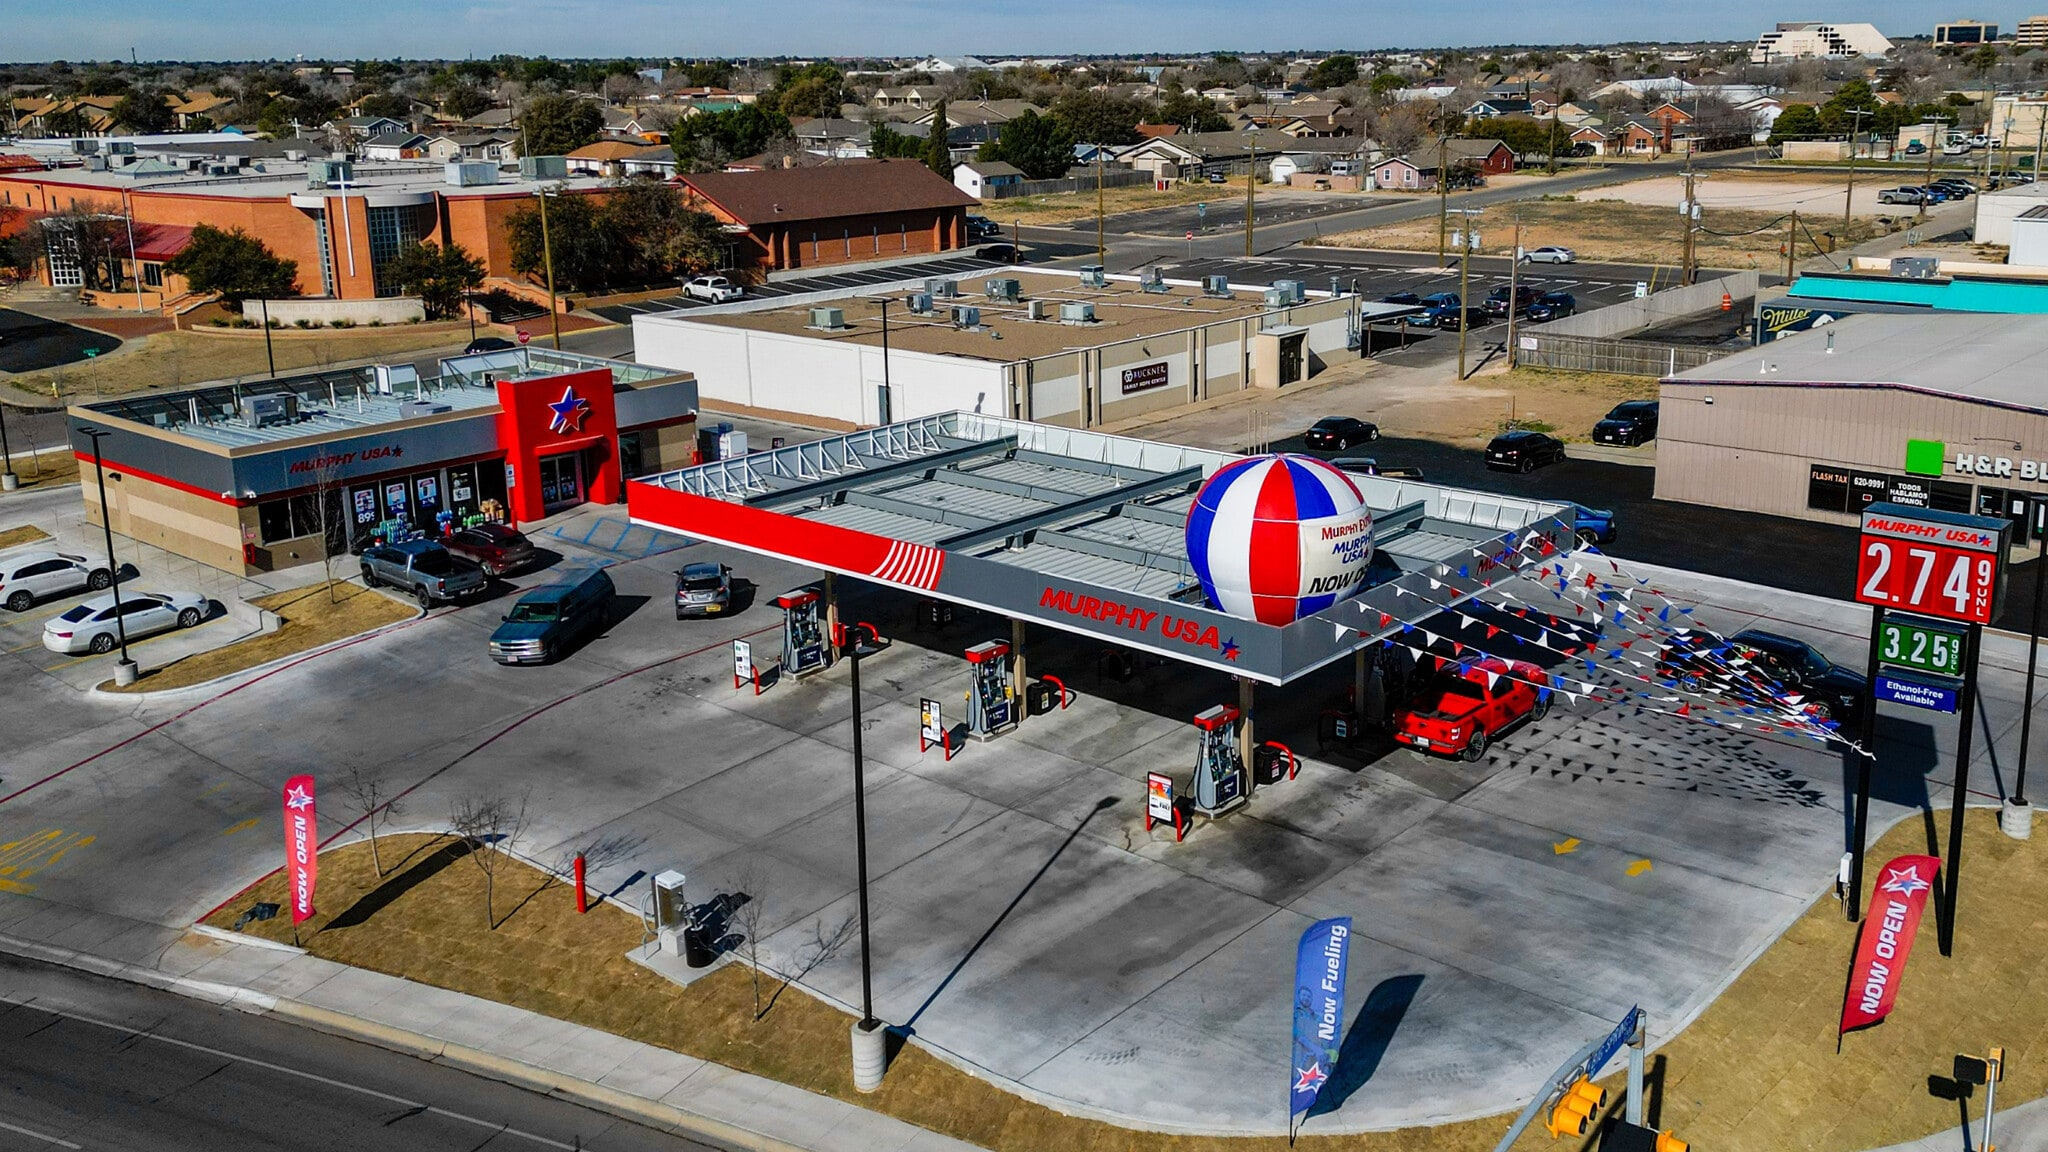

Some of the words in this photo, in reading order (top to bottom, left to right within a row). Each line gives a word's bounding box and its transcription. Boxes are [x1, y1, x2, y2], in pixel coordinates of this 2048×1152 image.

[1762, 308, 1813, 328] Miller
[1134, 366, 1166, 378] BUCKNER
[290, 452, 357, 473] MURPHY
[361, 446, 390, 461] USA
[1956, 453, 2014, 477] H&R
[1811, 471, 1833, 483] FLASH
[1834, 474, 1848, 484] TAX
[1854, 476, 1885, 490] 620-9991
[1898, 482, 1922, 491] TODOS
[1890, 489, 1928, 500] HABLAMOS
[1322, 522, 1358, 540] MURPHY
[1866, 518, 1942, 538] MURPHY
[1946, 530, 1980, 544] USA
[1342, 548, 1363, 564] USA
[1308, 571, 1353, 594] NOW
[1976, 588, 1987, 616] UNL
[1039, 587, 1158, 632] MURPHY
[1161, 615, 1219, 650] USA
[1886, 681, 1944, 699] Ethanol-Free
[1894, 692, 1935, 706] Available
[294, 815, 307, 864] OPEN
[297, 866, 308, 913] NOW
[1322, 924, 1348, 993] Fueling
[1860, 961, 1889, 1014] NOW
[1875, 900, 1908, 960] OPEN
[1318, 996, 1337, 1040] Now
